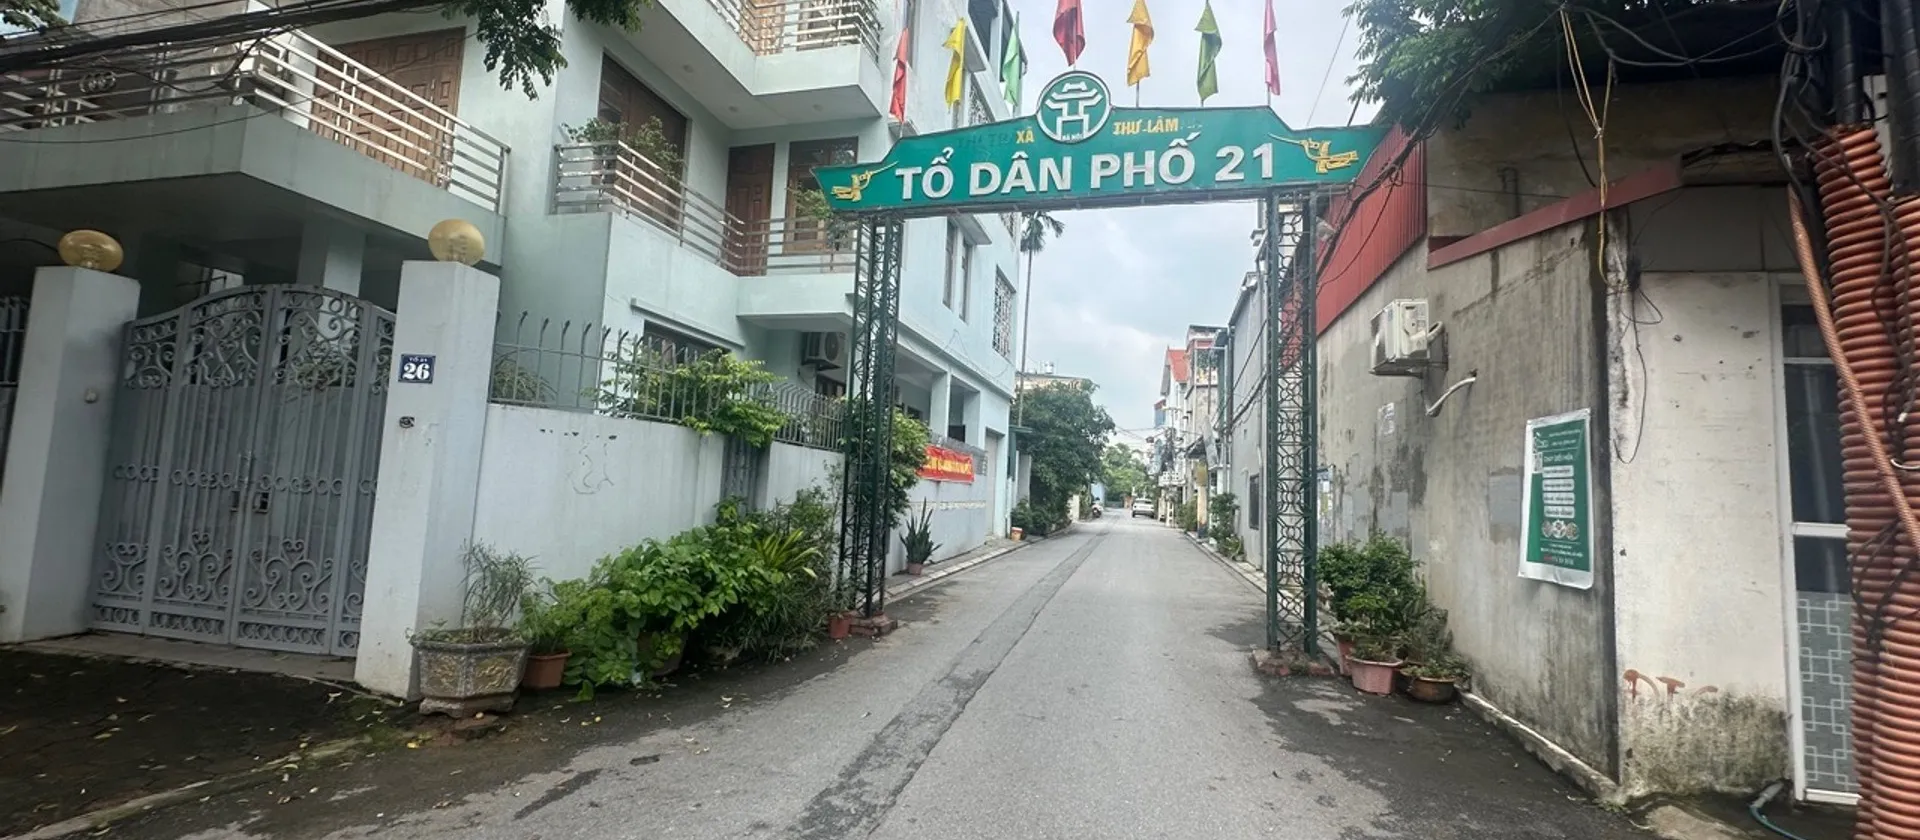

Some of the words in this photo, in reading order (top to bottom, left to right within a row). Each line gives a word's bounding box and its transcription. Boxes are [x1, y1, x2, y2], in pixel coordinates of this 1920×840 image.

[1016, 126, 1034, 144] XÃ
[1147, 116, 1178, 134] LÂM
[895, 147, 955, 200] TỔ
[969, 151, 1073, 197] DÂN
[1090, 132, 1201, 189] PHỐ
[1215, 143, 1274, 182] 21
[402, 363, 430, 380] 26
